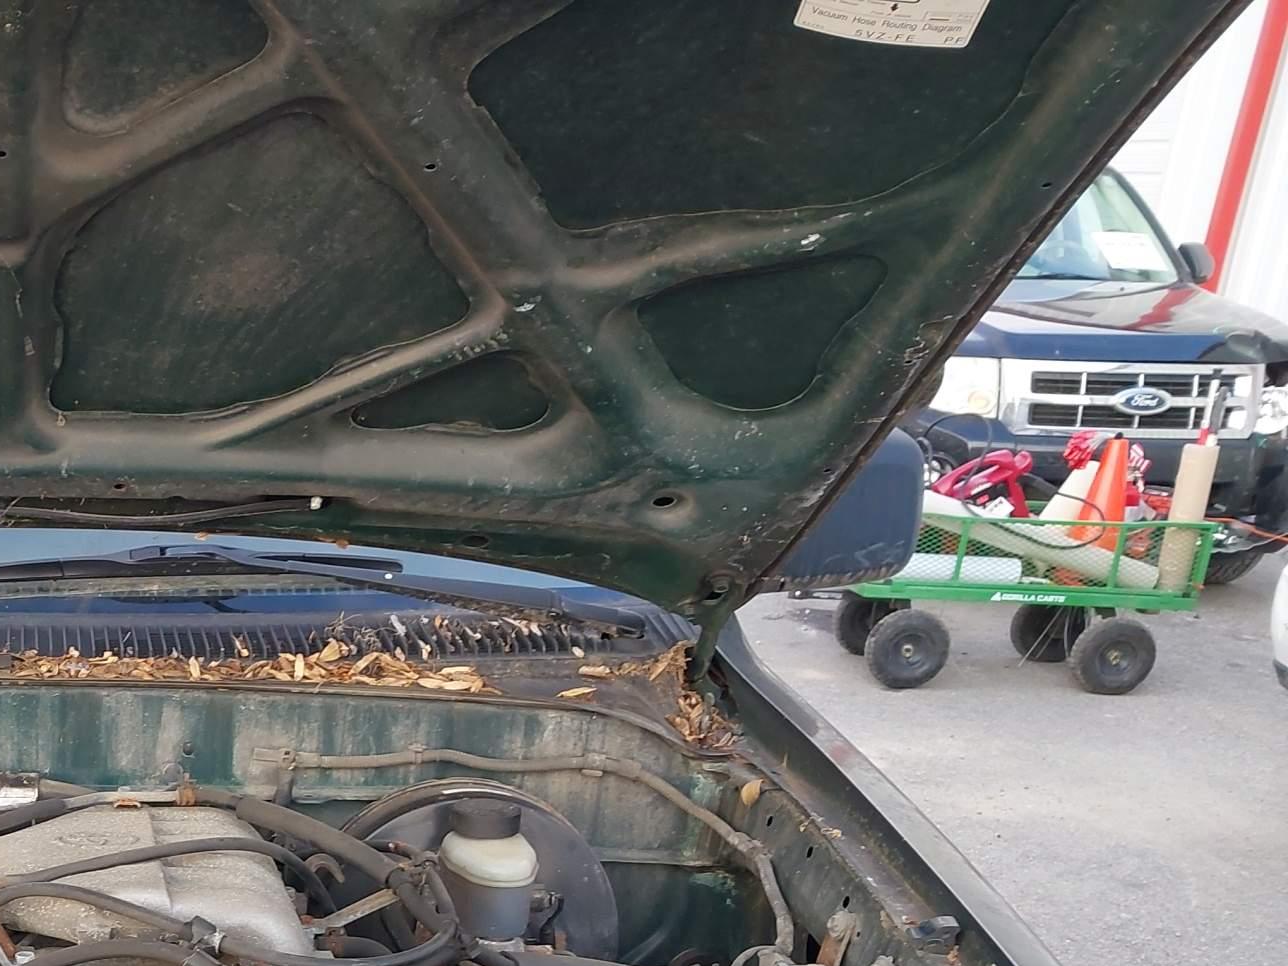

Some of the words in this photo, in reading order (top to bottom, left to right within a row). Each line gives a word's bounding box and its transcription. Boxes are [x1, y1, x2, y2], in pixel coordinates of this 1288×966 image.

[812, 6, 849, 21] Vacuum
[853, 16, 876, 27] Hose
[881, 20, 918, 32] Routing
[922, 23, 963, 33] Diagram
[1130, 394, 1160, 407] Ford
